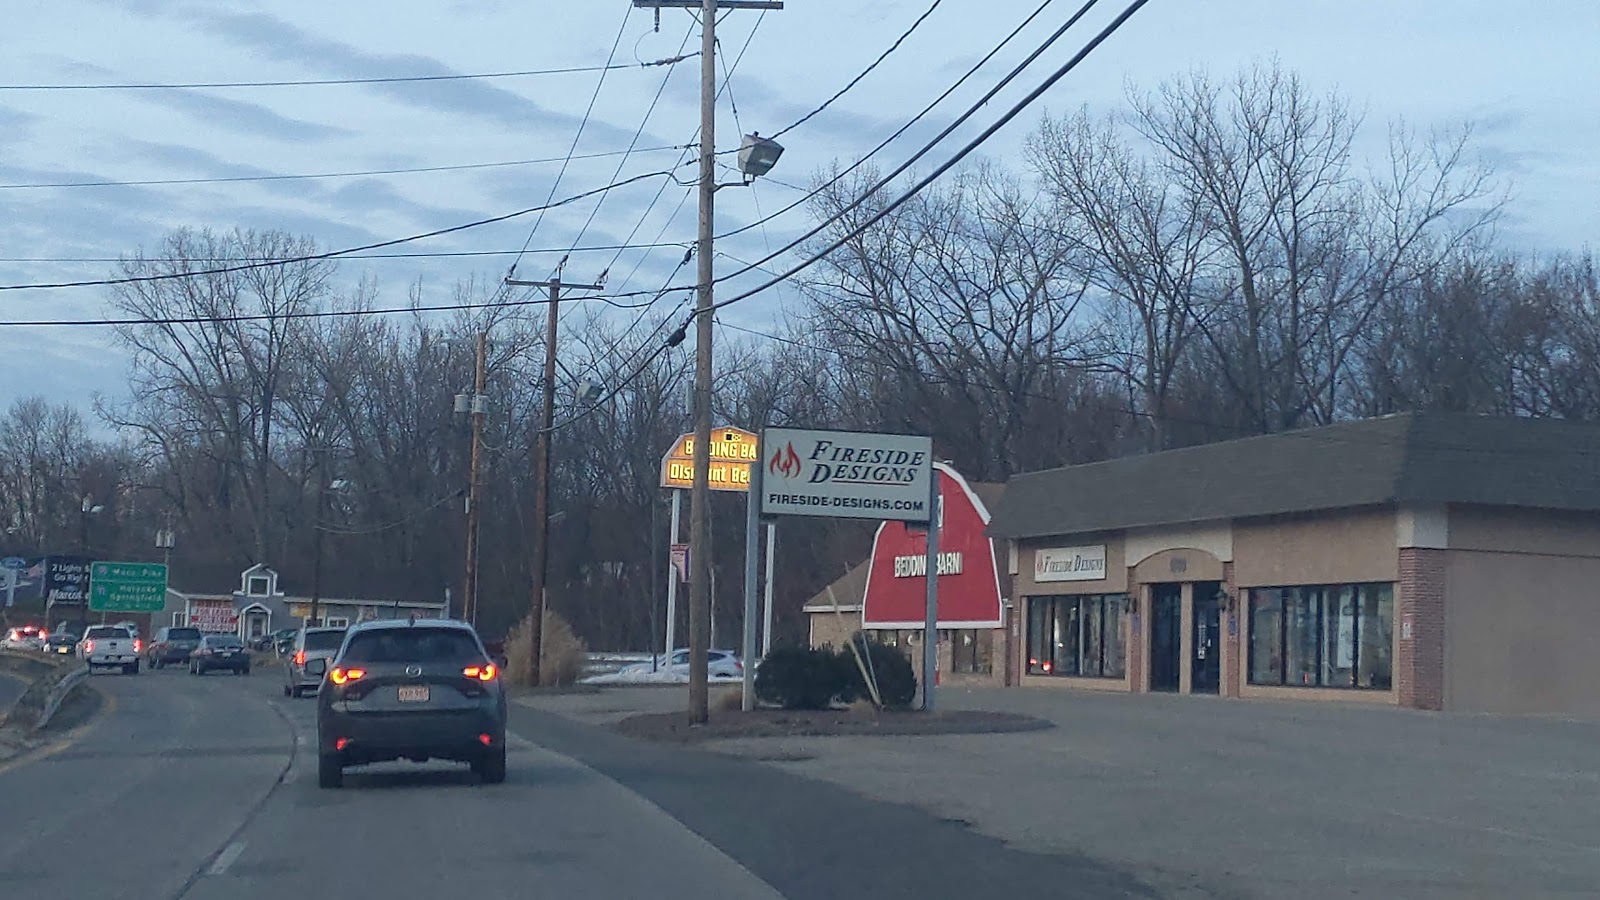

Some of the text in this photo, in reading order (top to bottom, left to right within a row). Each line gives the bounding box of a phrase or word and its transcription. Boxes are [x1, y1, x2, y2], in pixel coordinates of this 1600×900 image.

[808, 440, 925, 466] FIRESIDE
[808, 464, 917, 483] DESIGNS
[769, 494, 924, 511] FIRESIDE-DESIGNS.COM
[894, 555, 927, 577] BEDDIN
